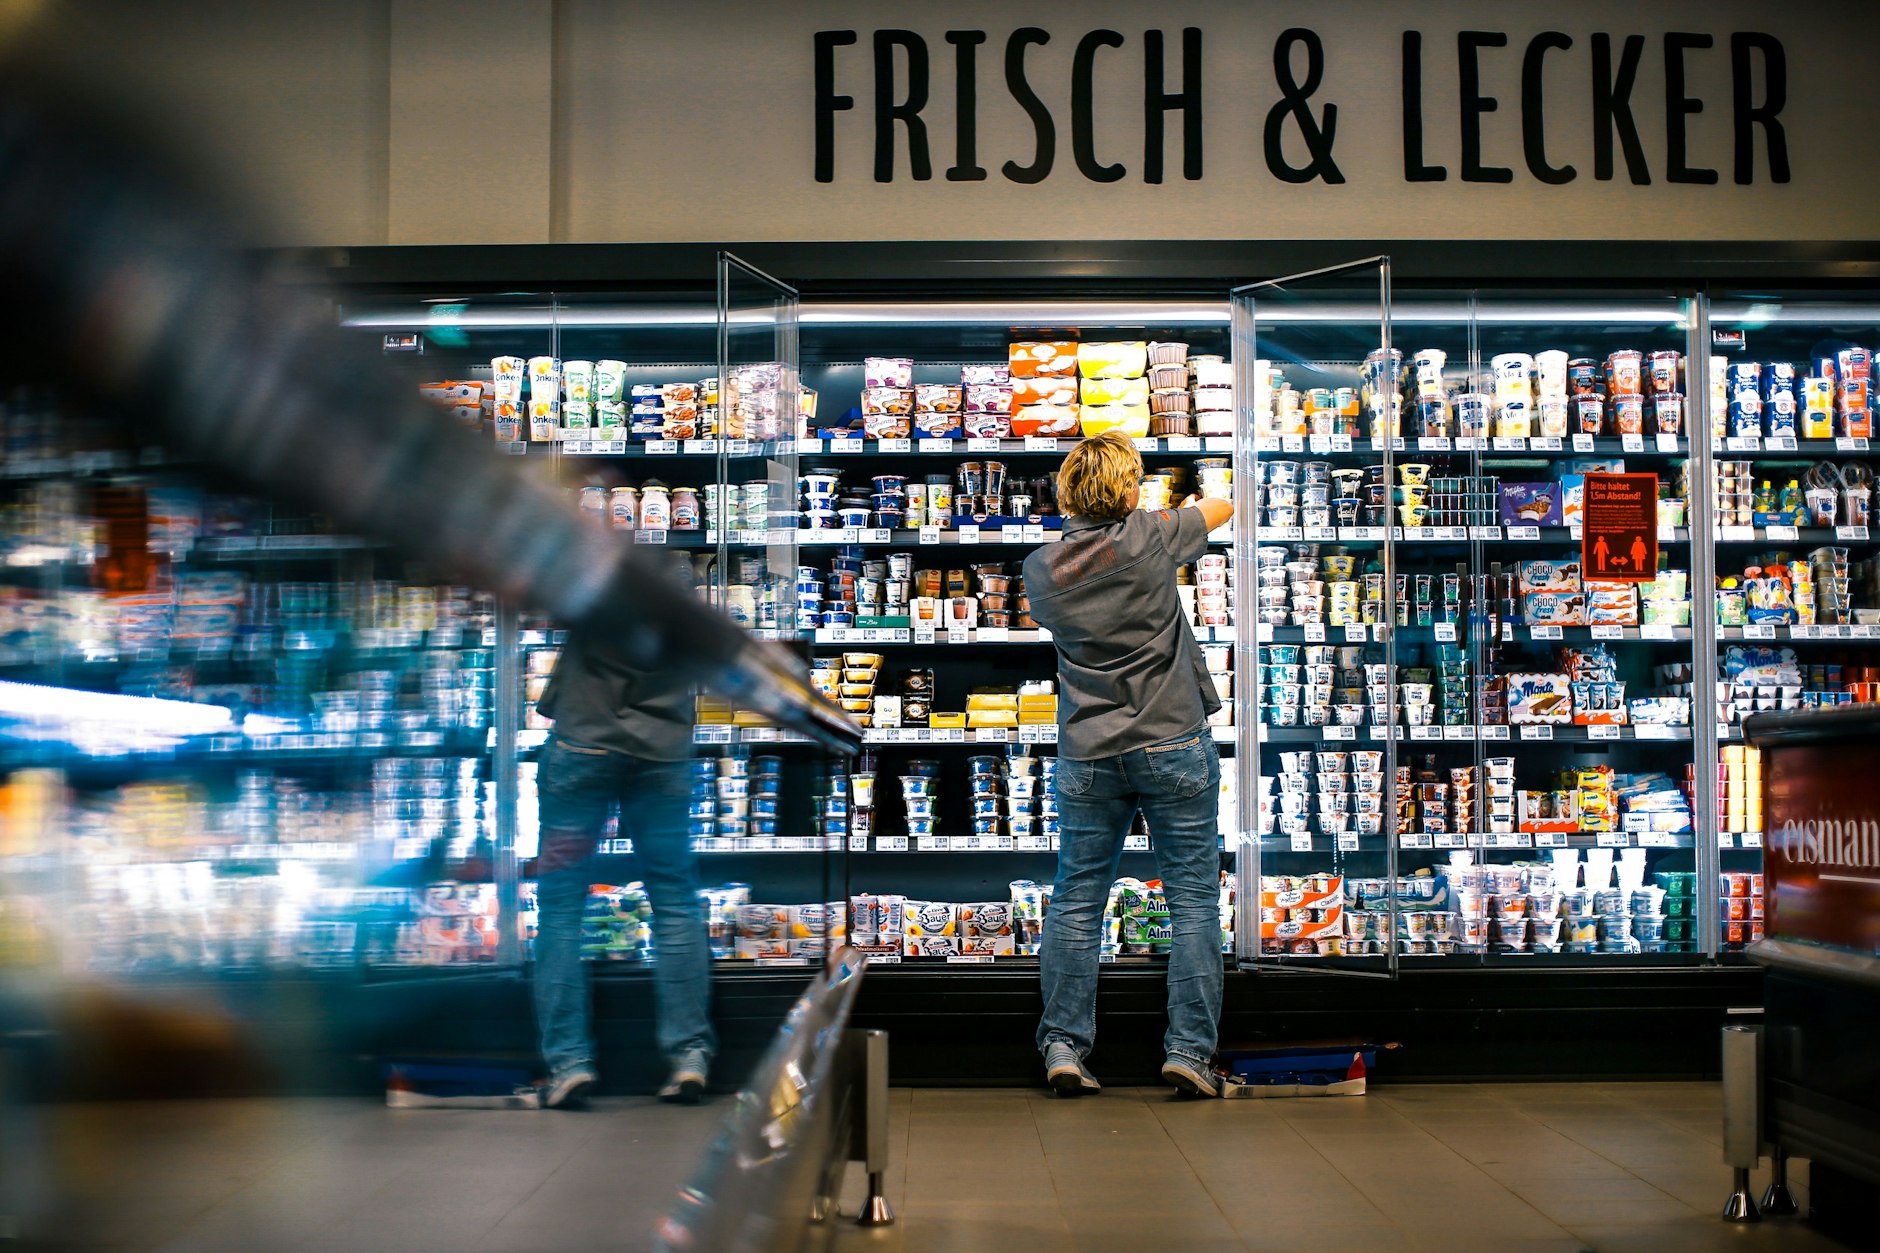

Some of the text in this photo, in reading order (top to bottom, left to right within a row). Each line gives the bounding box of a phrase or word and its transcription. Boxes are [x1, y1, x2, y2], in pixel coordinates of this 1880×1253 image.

[814, 27, 1790, 185] FRISCH & LECKER
[497, 416, 522, 425] Onken
[1590, 482, 1630, 490] Bitte haltet
[1503, 486, 1526, 497] Milka
[1606, 492, 1641, 500] Abstand!
[1527, 565, 1553, 574] CHOCO
[1530, 573, 1550, 581] fresh
[1532, 598, 1558, 607] CHOCO
[1536, 606, 1555, 614] fresh
[1742, 650, 1783, 668] Monte
[1522, 681, 1554, 698] Monte
[1320, 895, 1339, 906] Classic
[1146, 900, 1168, 912] Alm
[919, 914, 950, 925] Bauer
[976, 914, 1008, 925] Bauer
[1148, 928, 1171, 938] Alm
[1320, 926, 1338, 936] Classic
